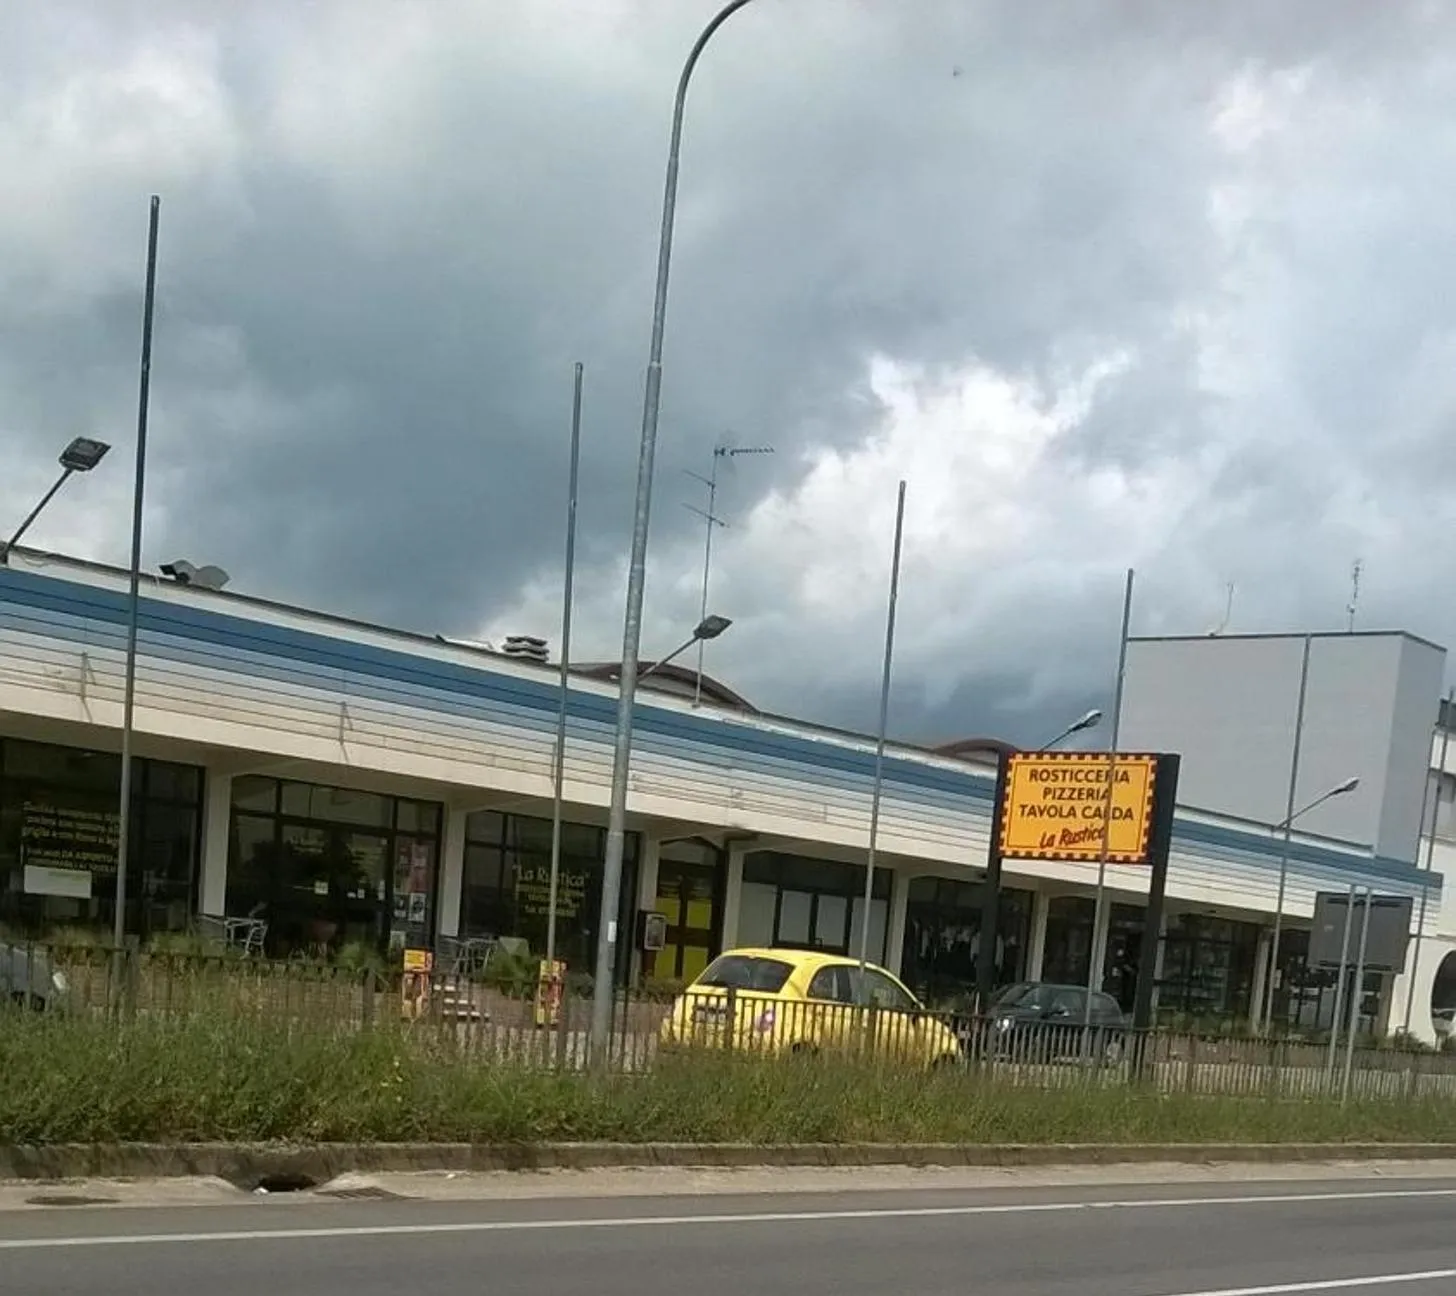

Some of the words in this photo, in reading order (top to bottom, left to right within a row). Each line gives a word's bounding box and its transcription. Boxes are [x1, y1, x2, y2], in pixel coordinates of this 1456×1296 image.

[1042, 787, 1110, 801] PIZZERIA
[1020, 804, 1077, 819] TAVOLA
[1039, 830, 1056, 849] La
